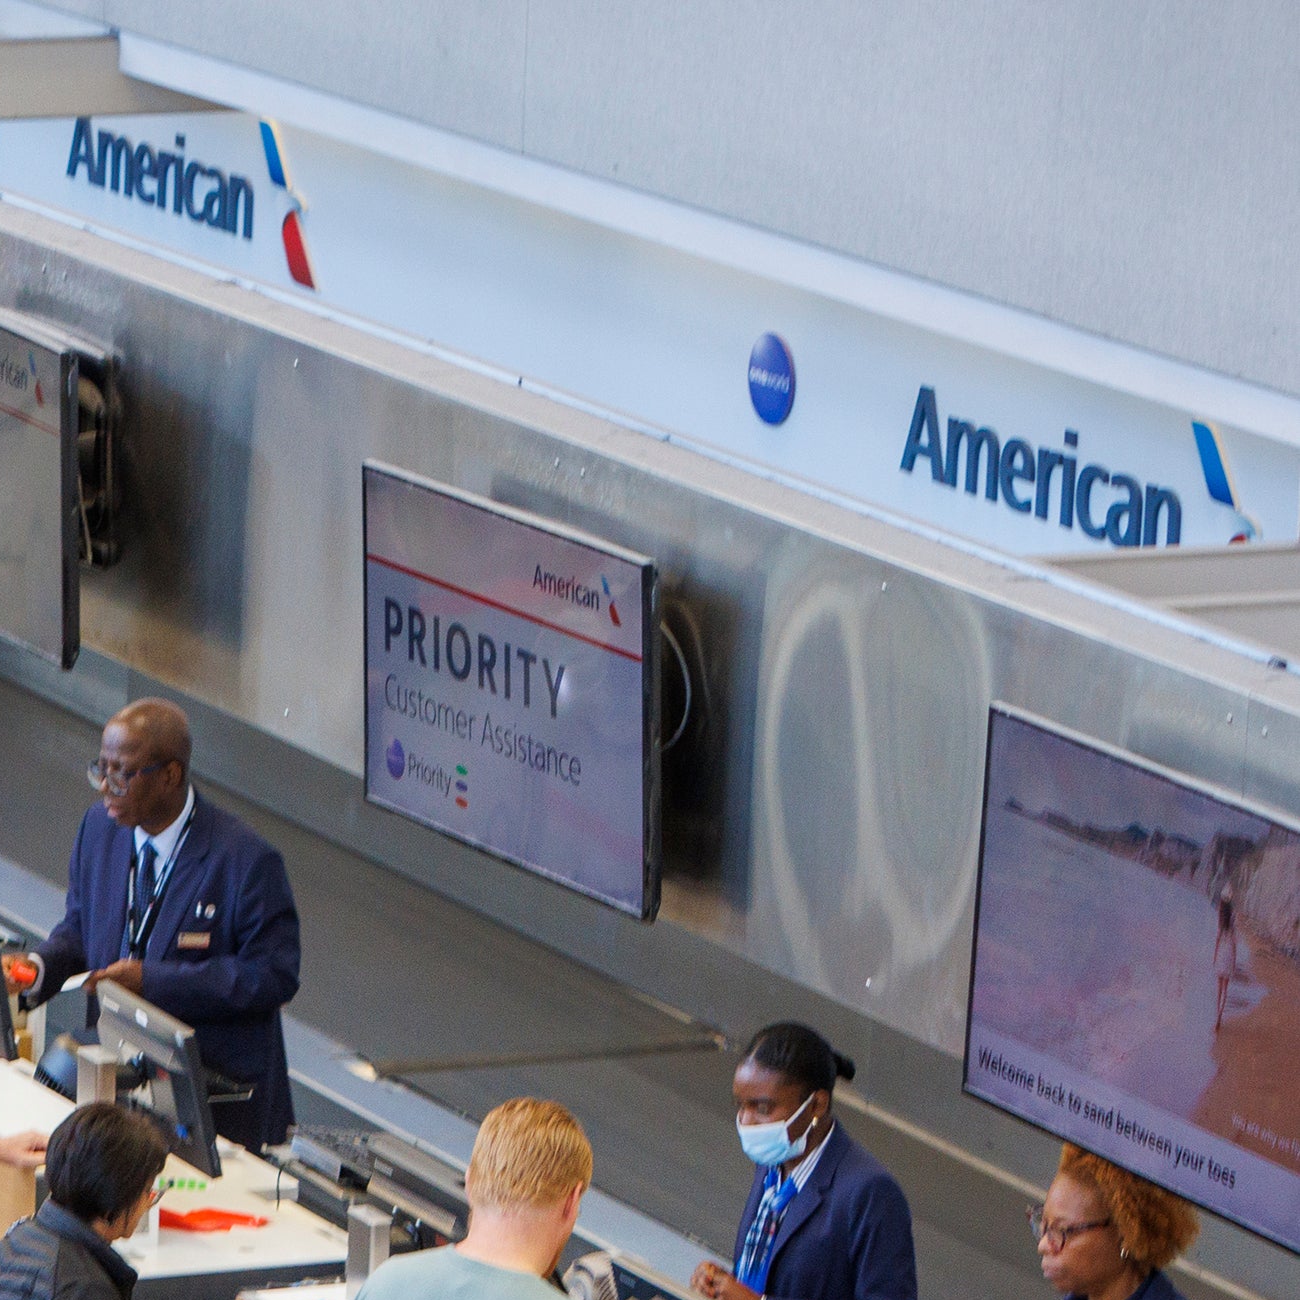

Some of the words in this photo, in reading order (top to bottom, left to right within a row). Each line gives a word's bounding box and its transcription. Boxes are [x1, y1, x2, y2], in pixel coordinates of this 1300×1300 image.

[67, 116, 254, 240] American
[900, 384, 1182, 547] American
[533, 564, 600, 611] American
[384, 596, 565, 719] PRIORITY
[384, 673, 476, 741] Customer
[481, 713, 582, 786] Assistance
[408, 753, 452, 798] Priority
[978, 1045, 1035, 1091] Welcome
[1037, 1072, 1066, 1108] back
[1069, 1090, 1081, 1113] to
[1083, 1098, 1114, 1130] sand
[1116, 1110, 1172, 1157] between
[1174, 1144, 1205, 1171] your
[1207, 1154, 1237, 1190] toes
